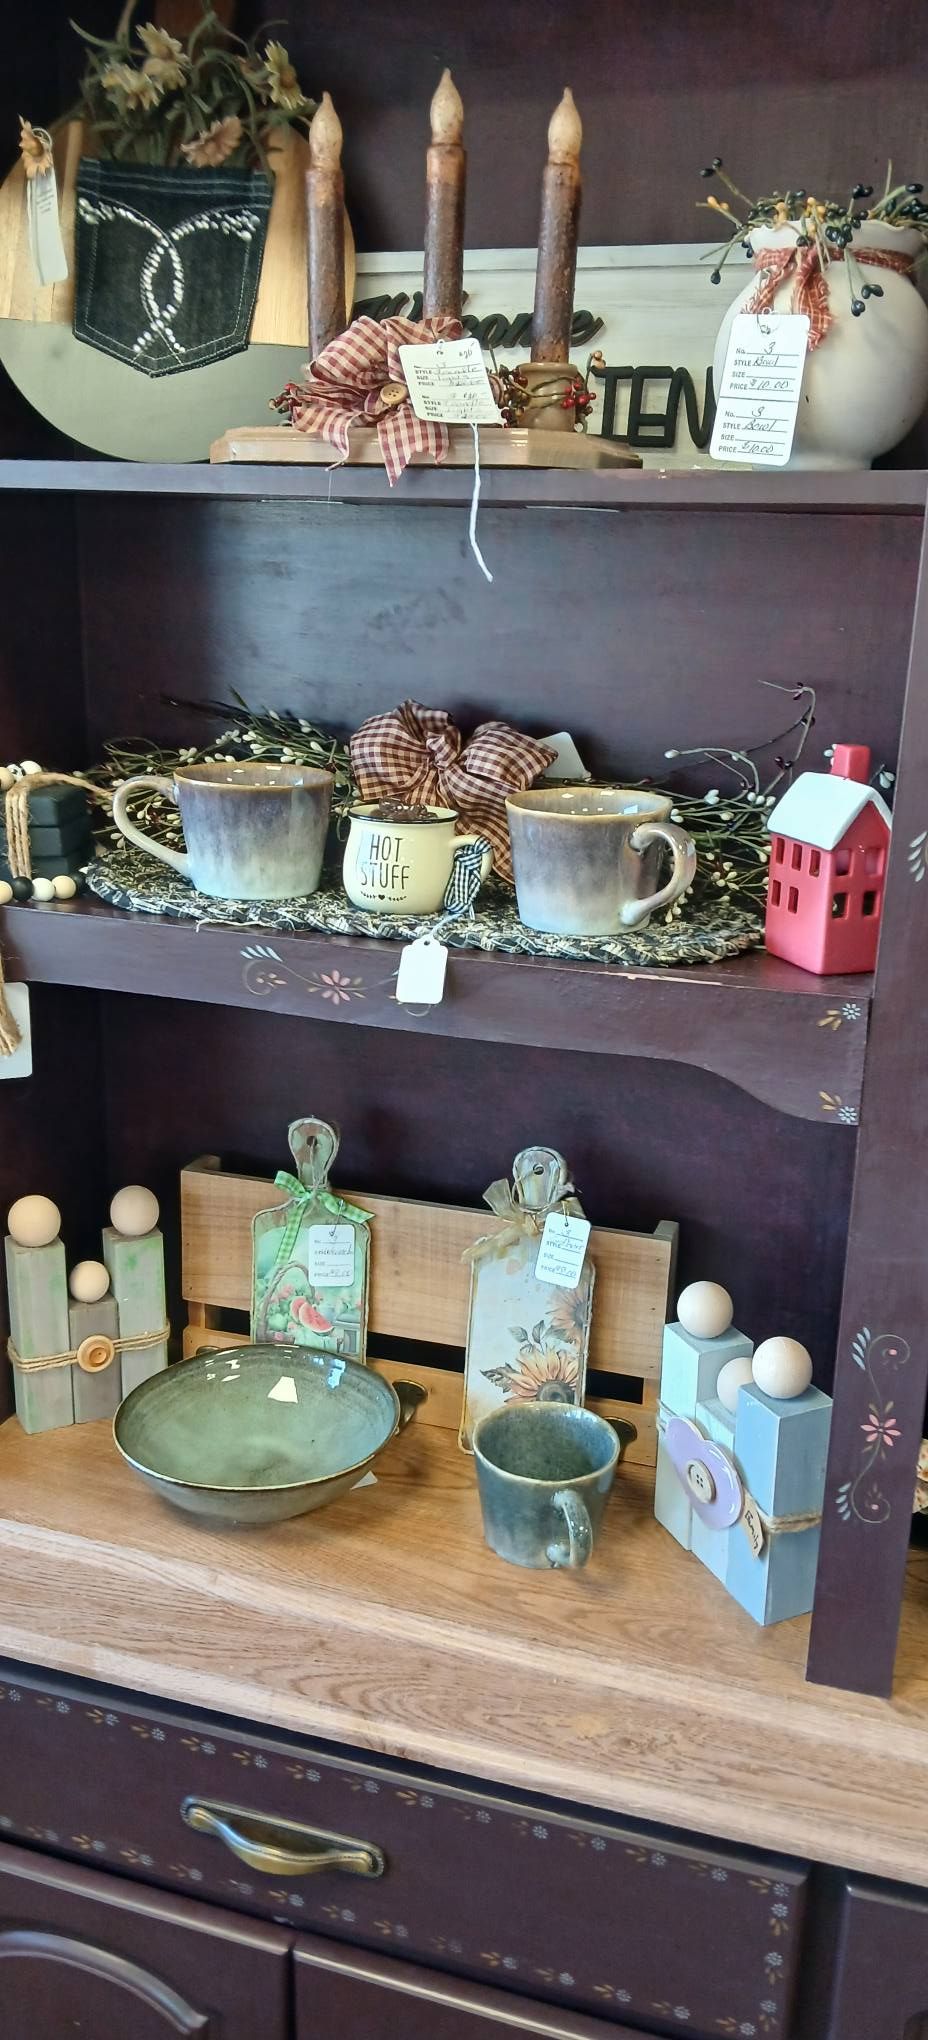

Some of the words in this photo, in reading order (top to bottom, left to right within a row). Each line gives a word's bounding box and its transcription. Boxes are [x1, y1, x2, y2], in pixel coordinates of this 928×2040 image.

[733, 359, 751, 367] STYLE
[729, 382, 748, 390] PRICE
[722, 422, 741, 430] STYLE
[718, 445, 737, 453] PRICE
[370, 834, 404, 862] HOT
[360, 862, 410, 890] STUFF
